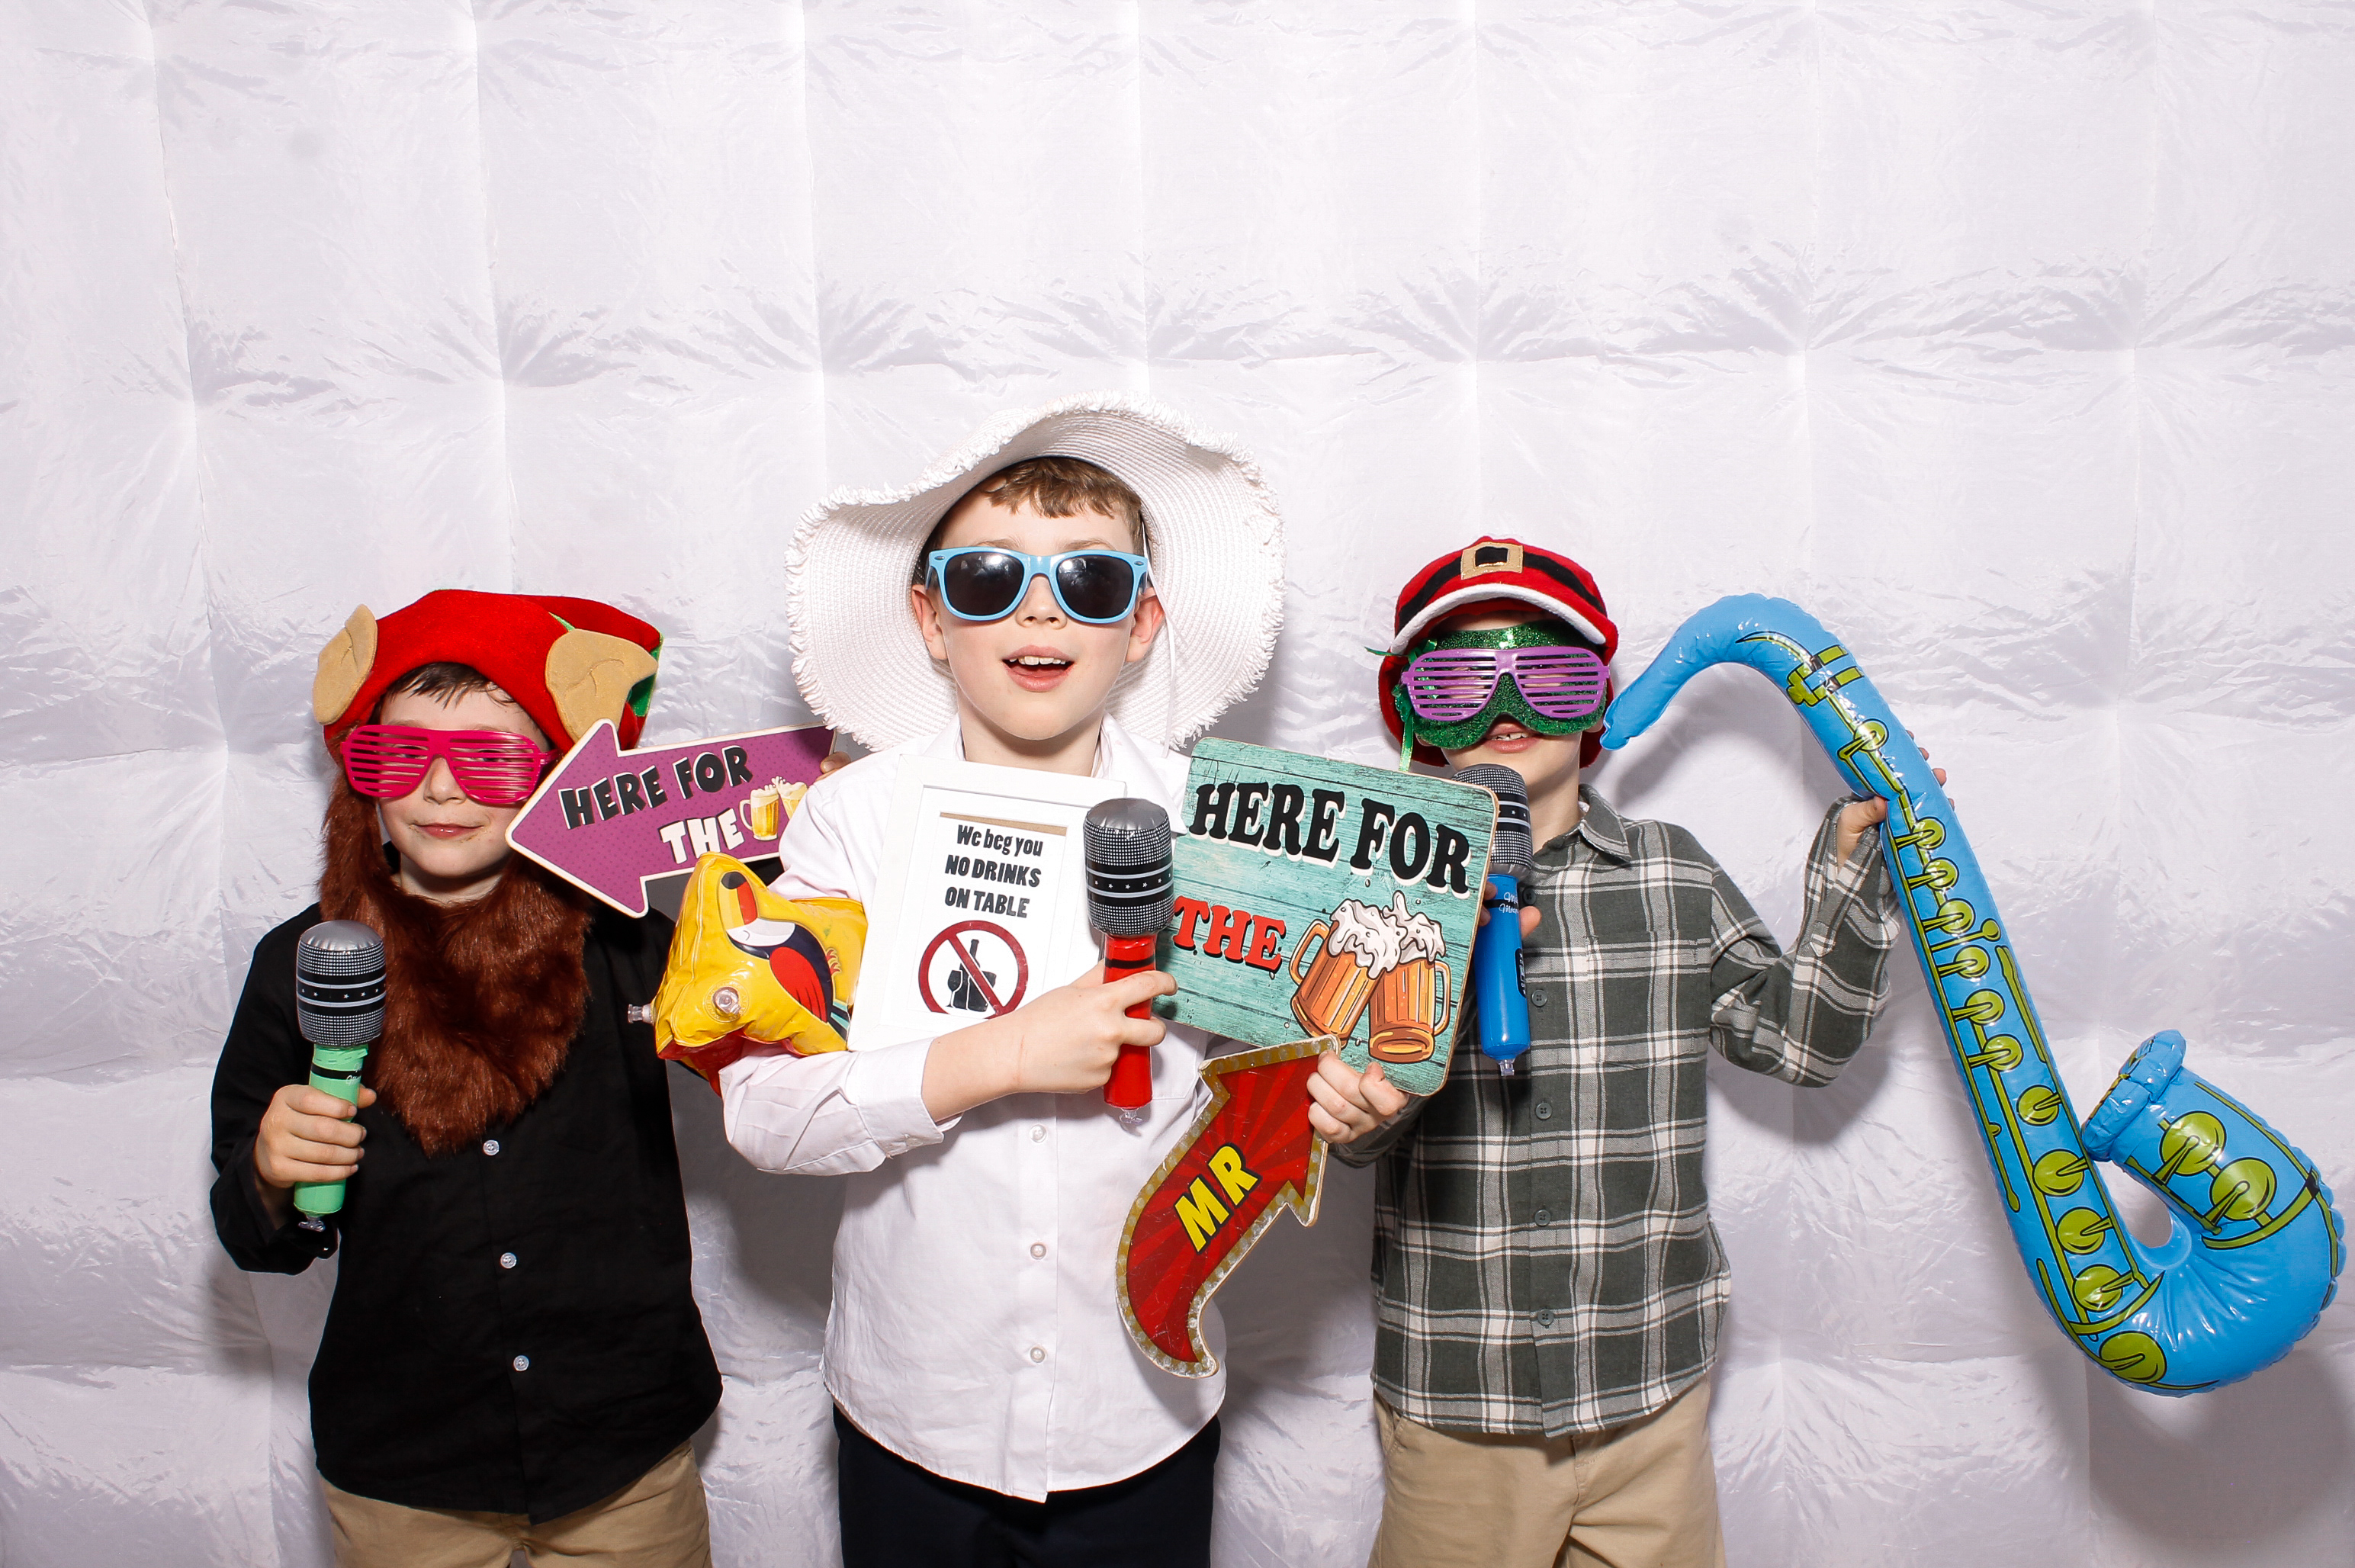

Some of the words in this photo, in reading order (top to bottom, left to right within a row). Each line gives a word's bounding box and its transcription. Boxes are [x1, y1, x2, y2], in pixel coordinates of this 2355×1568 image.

[558, 765, 668, 830] HERE
[673, 745, 753, 800] FOR
[659, 808, 745, 865] THE
[956, 824, 982, 847] We
[983, 828, 1013, 856] beg
[1014, 837, 1044, 857] you
[1188, 782, 1347, 866] HERE
[1349, 798, 1472, 898] FOR
[944, 854, 971, 876] NO
[971, 858, 1042, 888] DRINKS
[944, 887, 971, 909] ON
[973, 890, 1030, 918] TABLE
[1173, 895, 1287, 972] THE
[1173, 1142, 1262, 1255] MR
